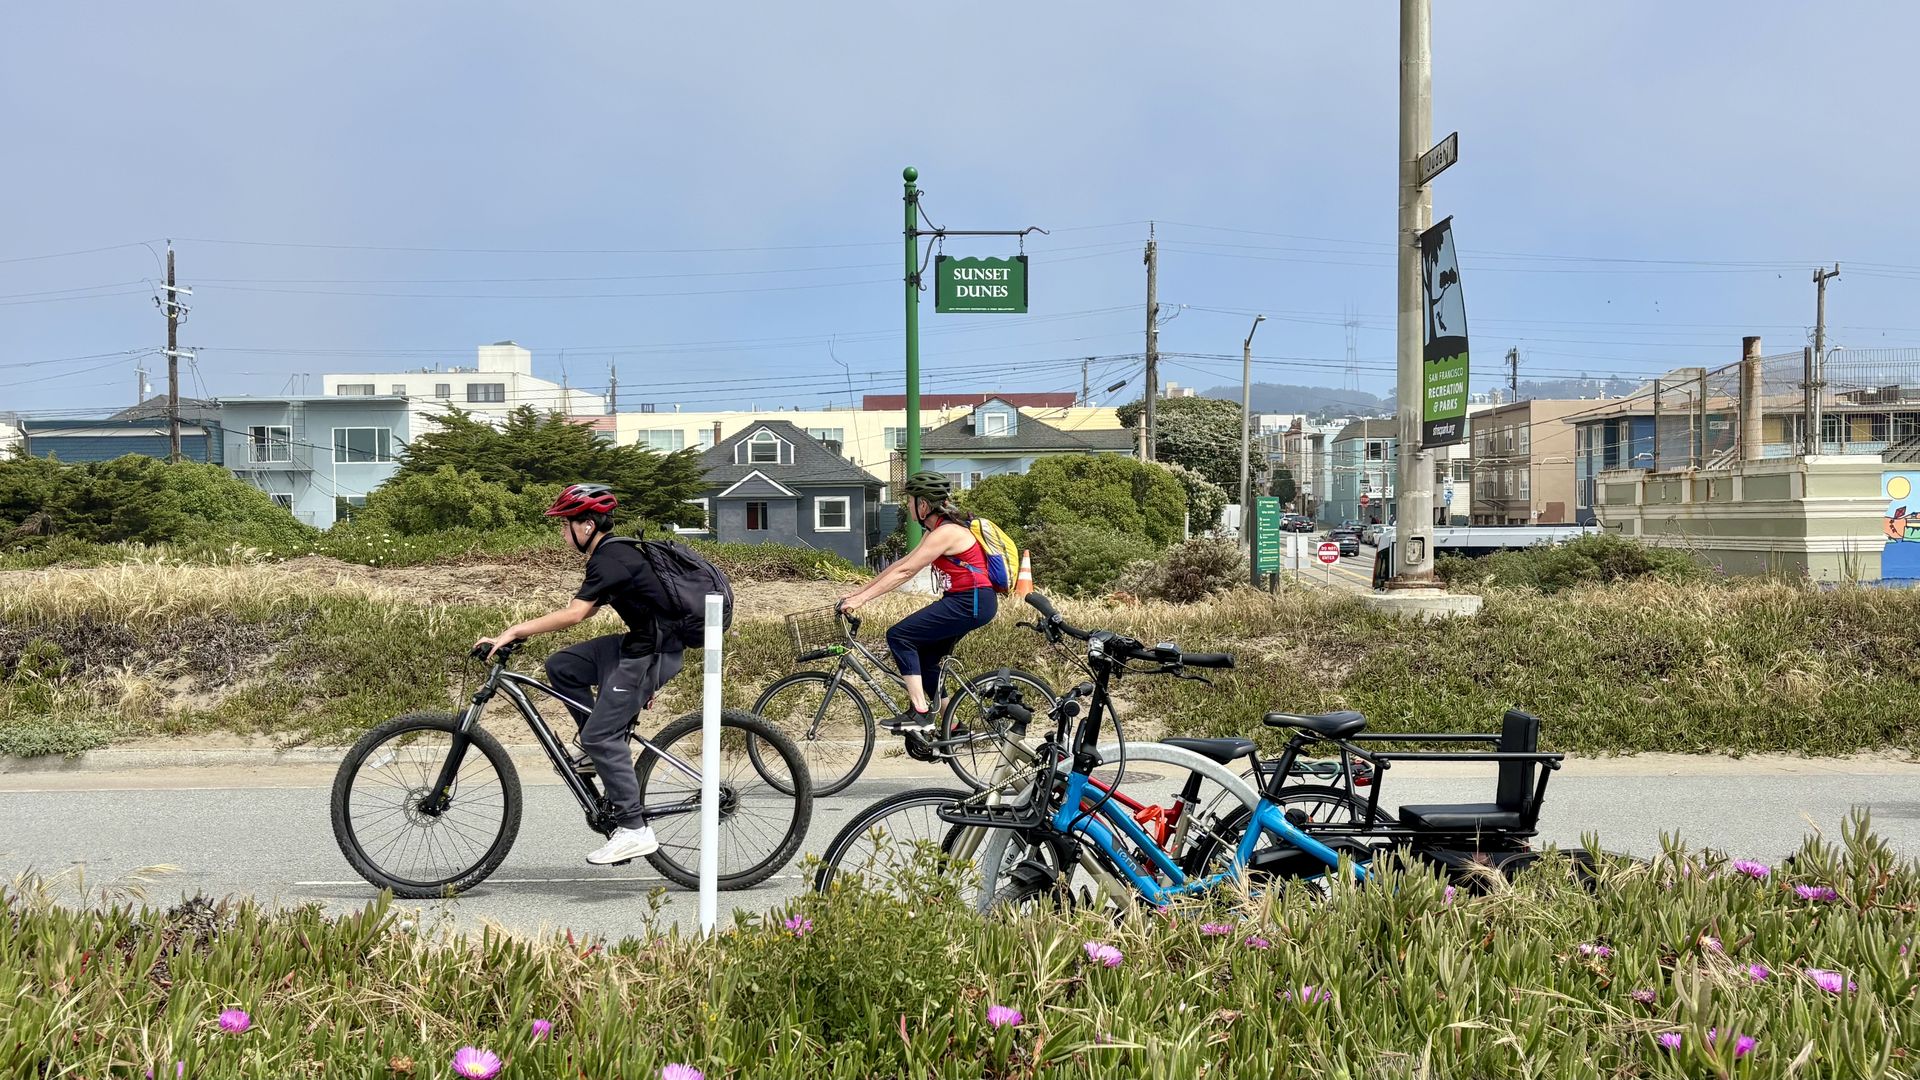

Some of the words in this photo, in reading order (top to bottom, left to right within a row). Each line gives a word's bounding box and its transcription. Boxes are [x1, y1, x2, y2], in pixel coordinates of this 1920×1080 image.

[953, 268, 1010, 280] SUNSET
[956, 285, 1008, 297] DUNES
[1428, 373, 1438, 382] SAN
[1439, 367, 1464, 380] FRANCISCO
[1428, 382, 1464, 398] RECREATION
[1440, 399, 1458, 411] PARKS
